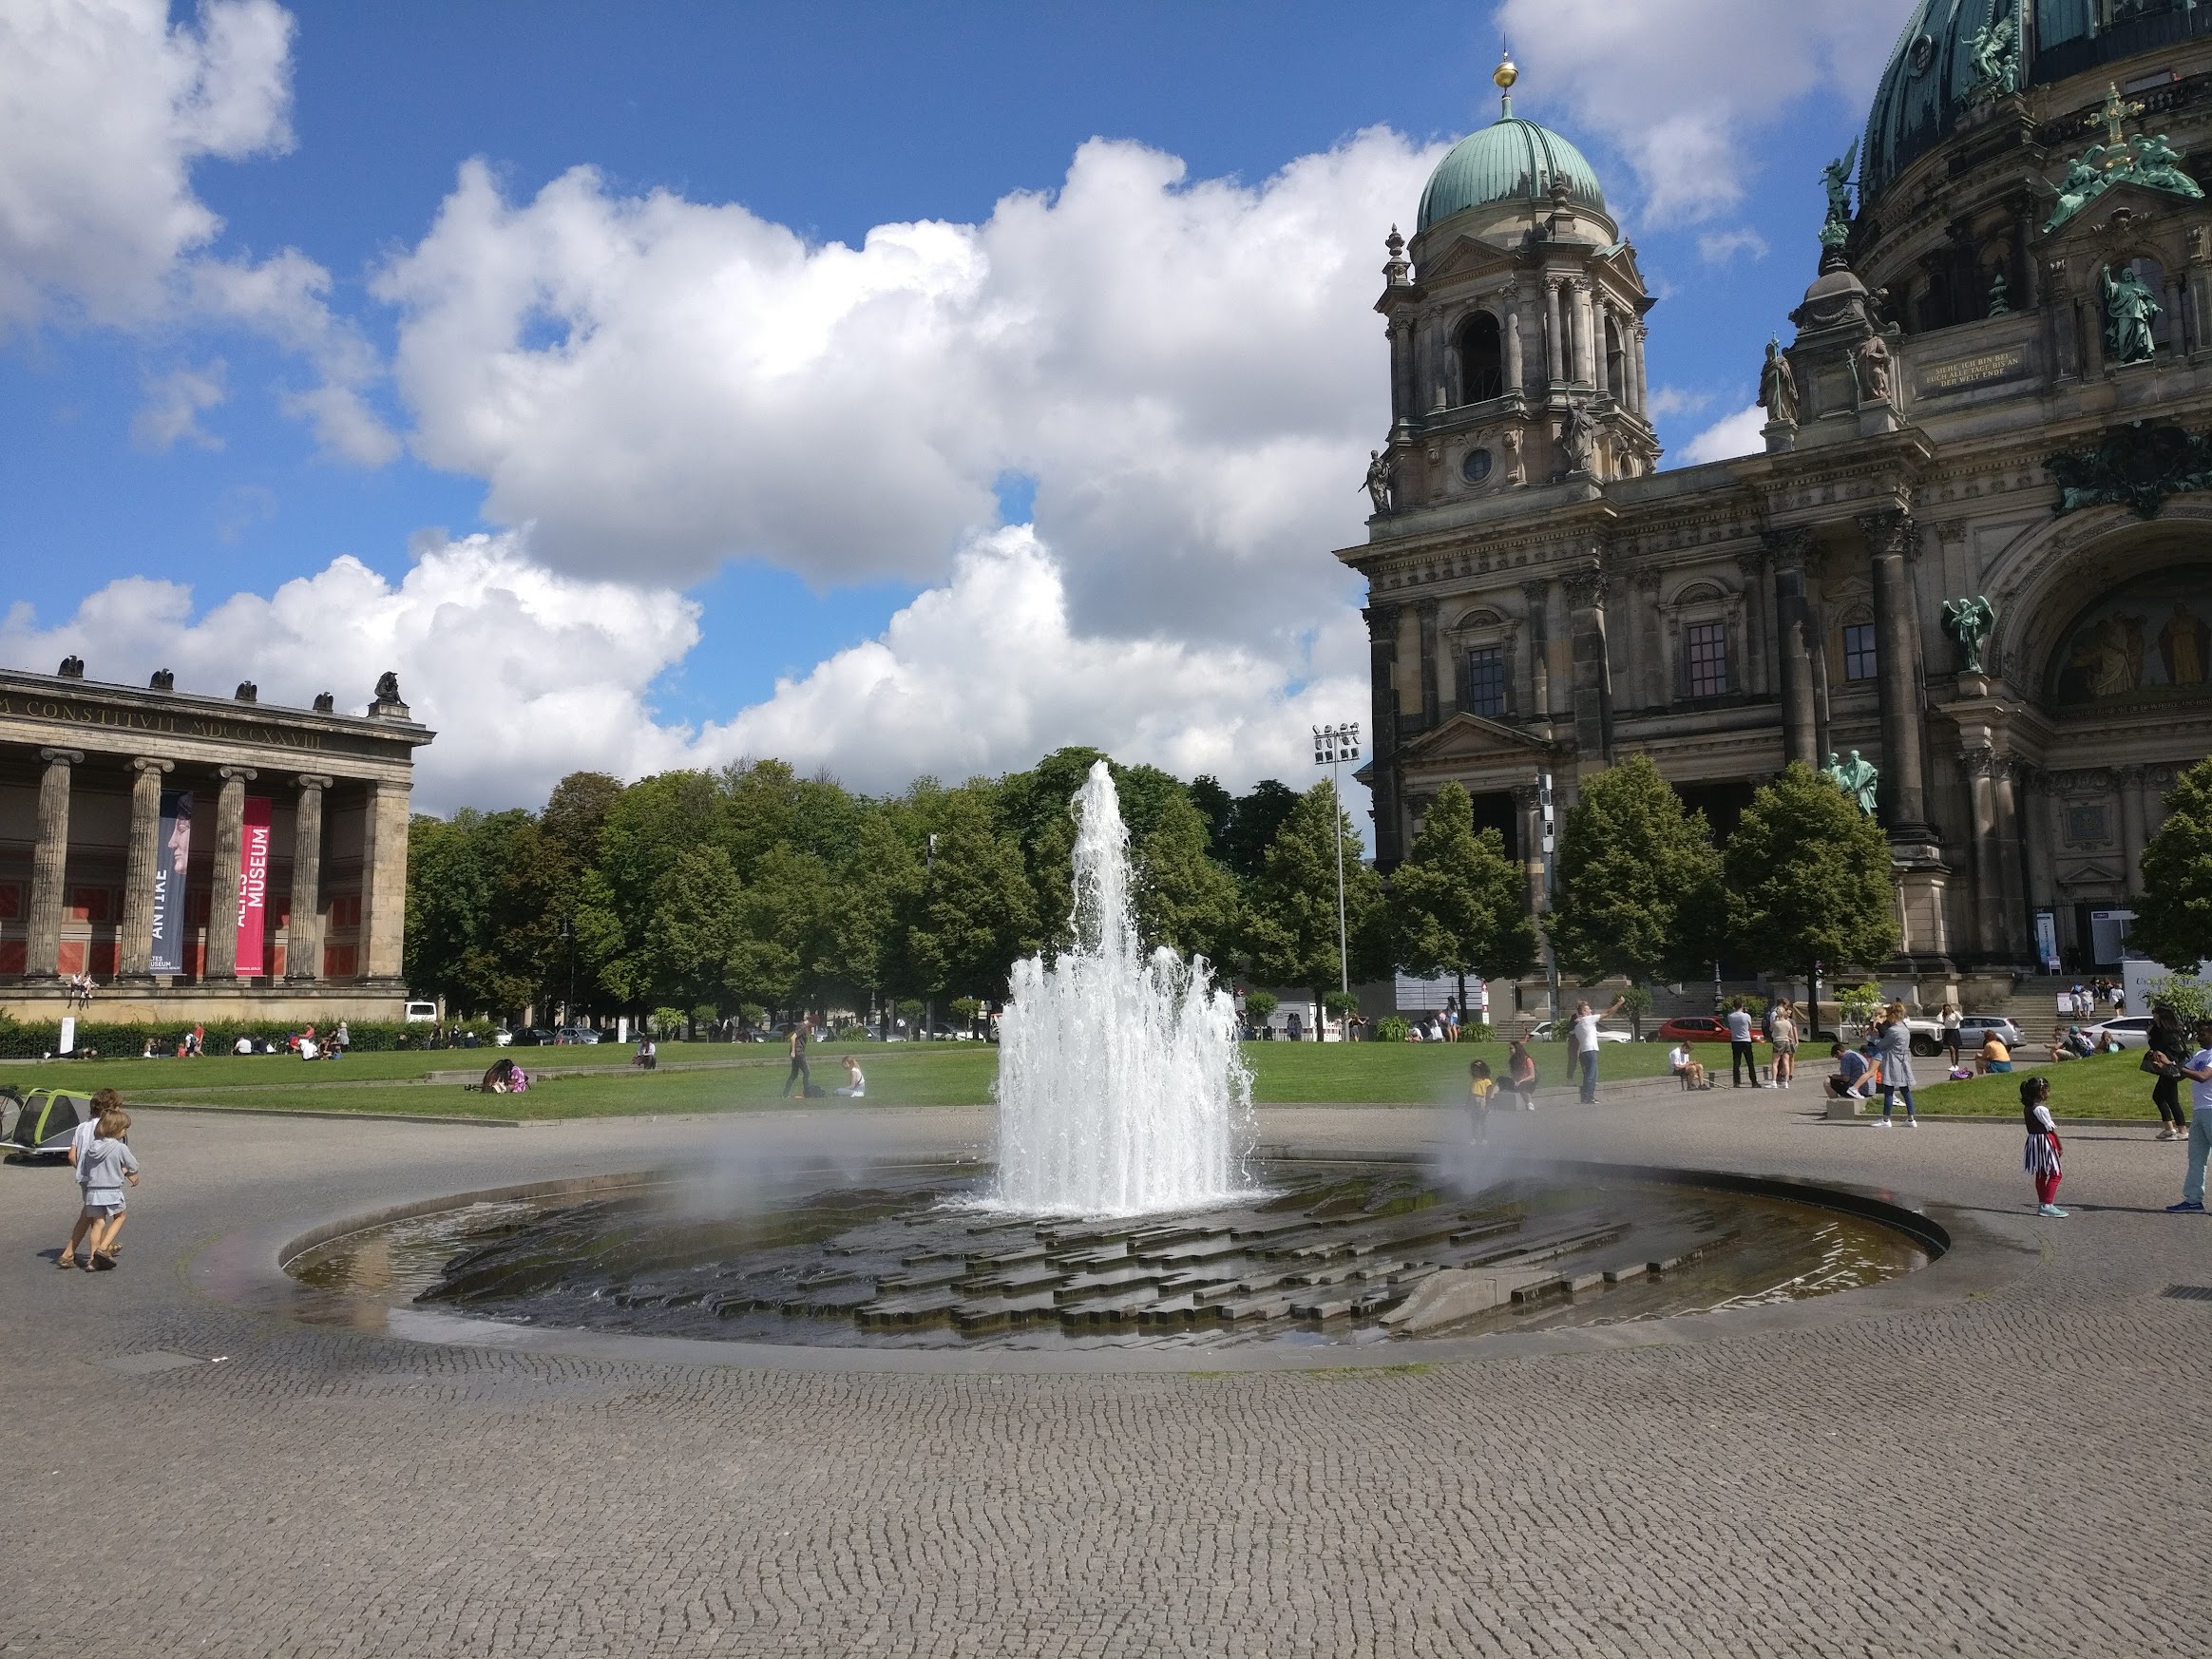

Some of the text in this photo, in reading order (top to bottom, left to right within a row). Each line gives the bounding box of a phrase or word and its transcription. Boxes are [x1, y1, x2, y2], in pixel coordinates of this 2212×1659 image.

[1926, 357, 2018, 384] EUCH ALLE TAGE BIS AN
[1941, 368, 2004, 388] DER WELT ENDE
[1961, 360, 1975, 369] ICH
[1977, 356, 1993, 366] BIN
[1994, 353, 2009, 362] BEI
[26, 700, 180, 734] CONSTITVIT
[188, 720, 321, 750] MDCCCXXVIII
[247, 829, 268, 907] MUSEUM
[152, 869, 167, 940] ANTIKE
